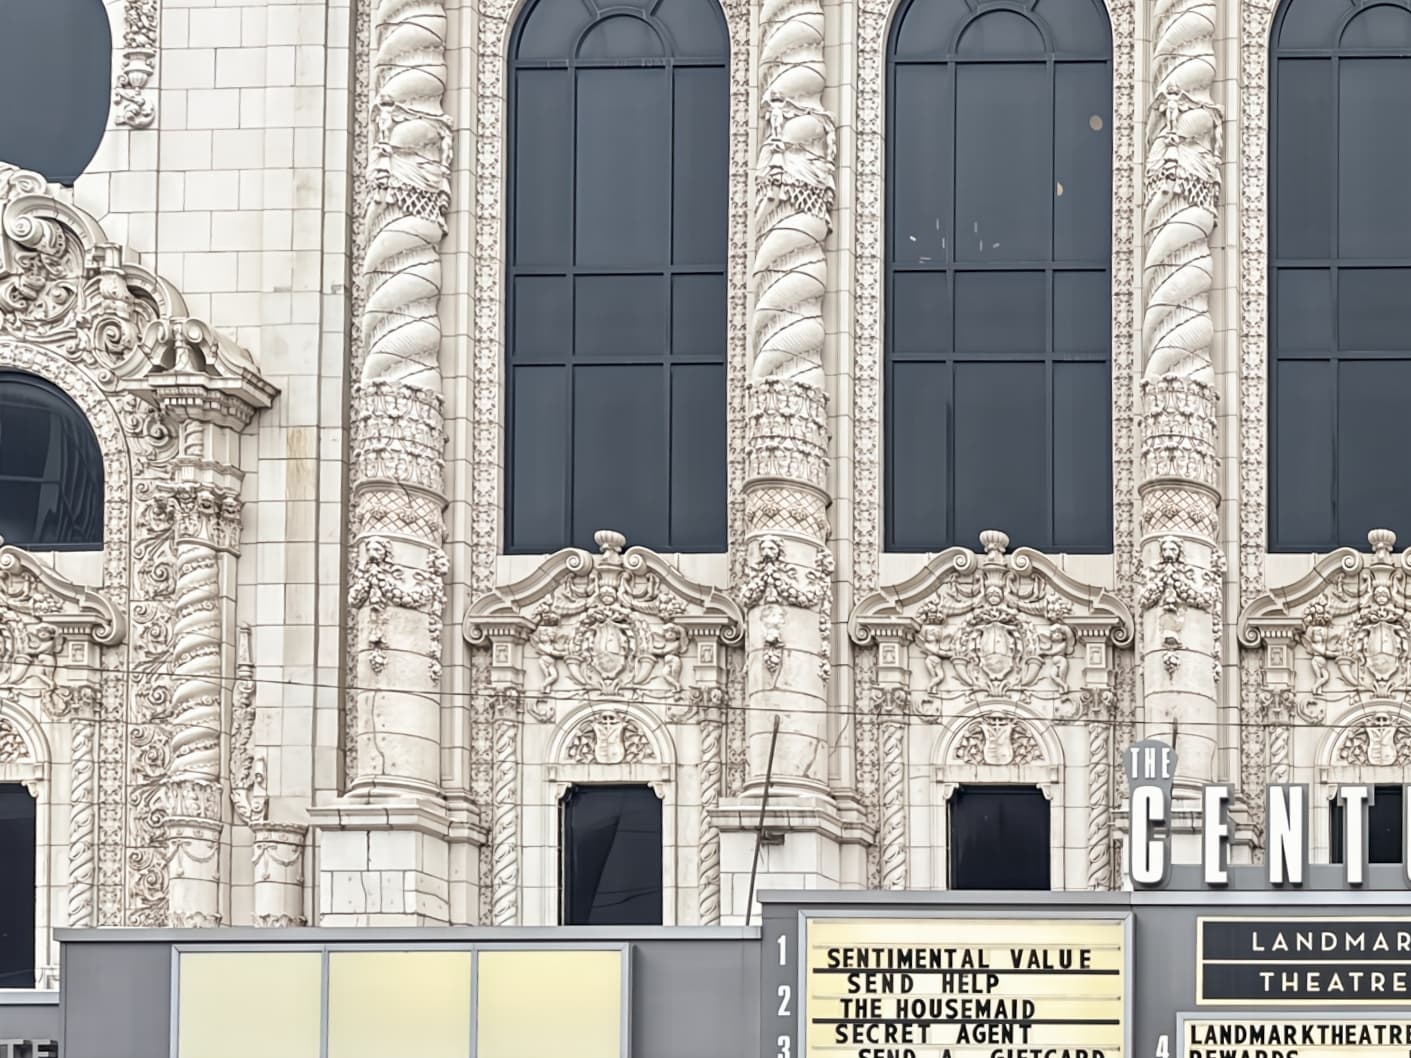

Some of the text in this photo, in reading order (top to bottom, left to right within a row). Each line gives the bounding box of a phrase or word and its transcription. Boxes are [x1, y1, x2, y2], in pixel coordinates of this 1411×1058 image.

[1130, 747, 1171, 779] THE
[777, 935, 787, 965] 1
[827, 948, 1092, 969] SENTIMENTAL VALUE
[847, 973, 1000, 994] SEND HELP
[777, 985, 791, 1016] 2
[840, 998, 1035, 1019] THE HOUSEMAID
[835, 1023, 1033, 1045] SECRET AGENT
